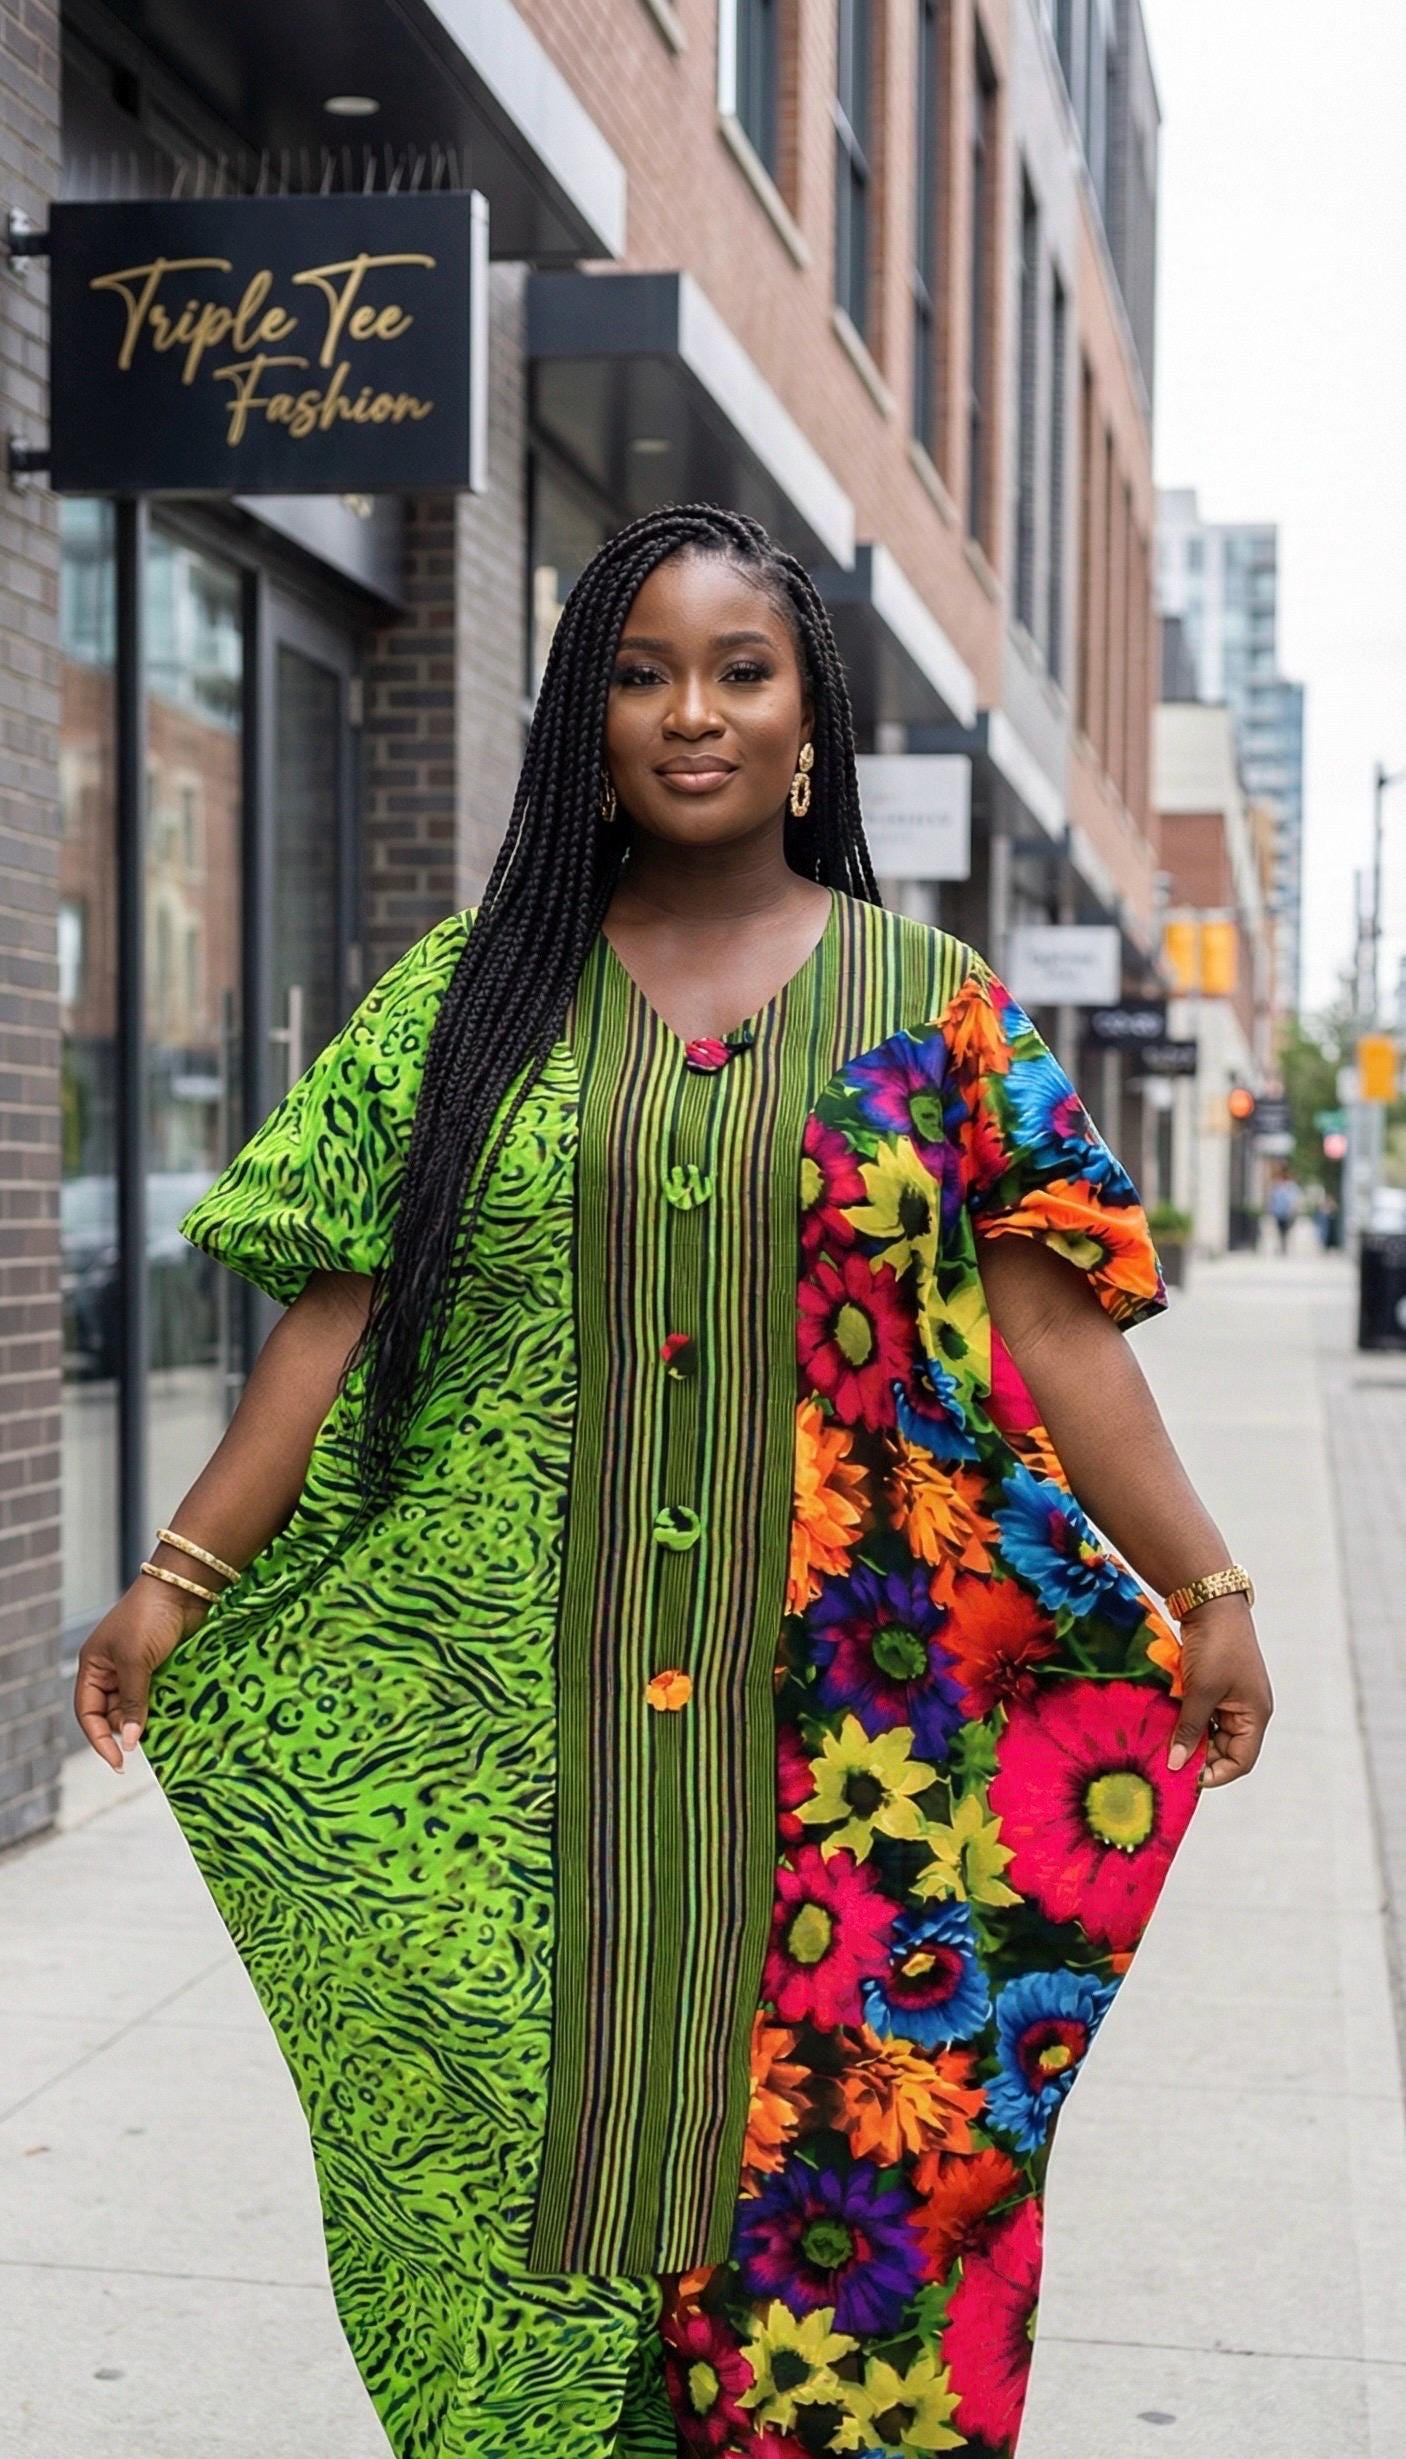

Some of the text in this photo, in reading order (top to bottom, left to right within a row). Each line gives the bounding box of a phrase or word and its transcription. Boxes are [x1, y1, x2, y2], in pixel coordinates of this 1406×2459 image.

[90, 253, 437, 386] Triple Tee
[213, 354, 433, 448] Fashion
